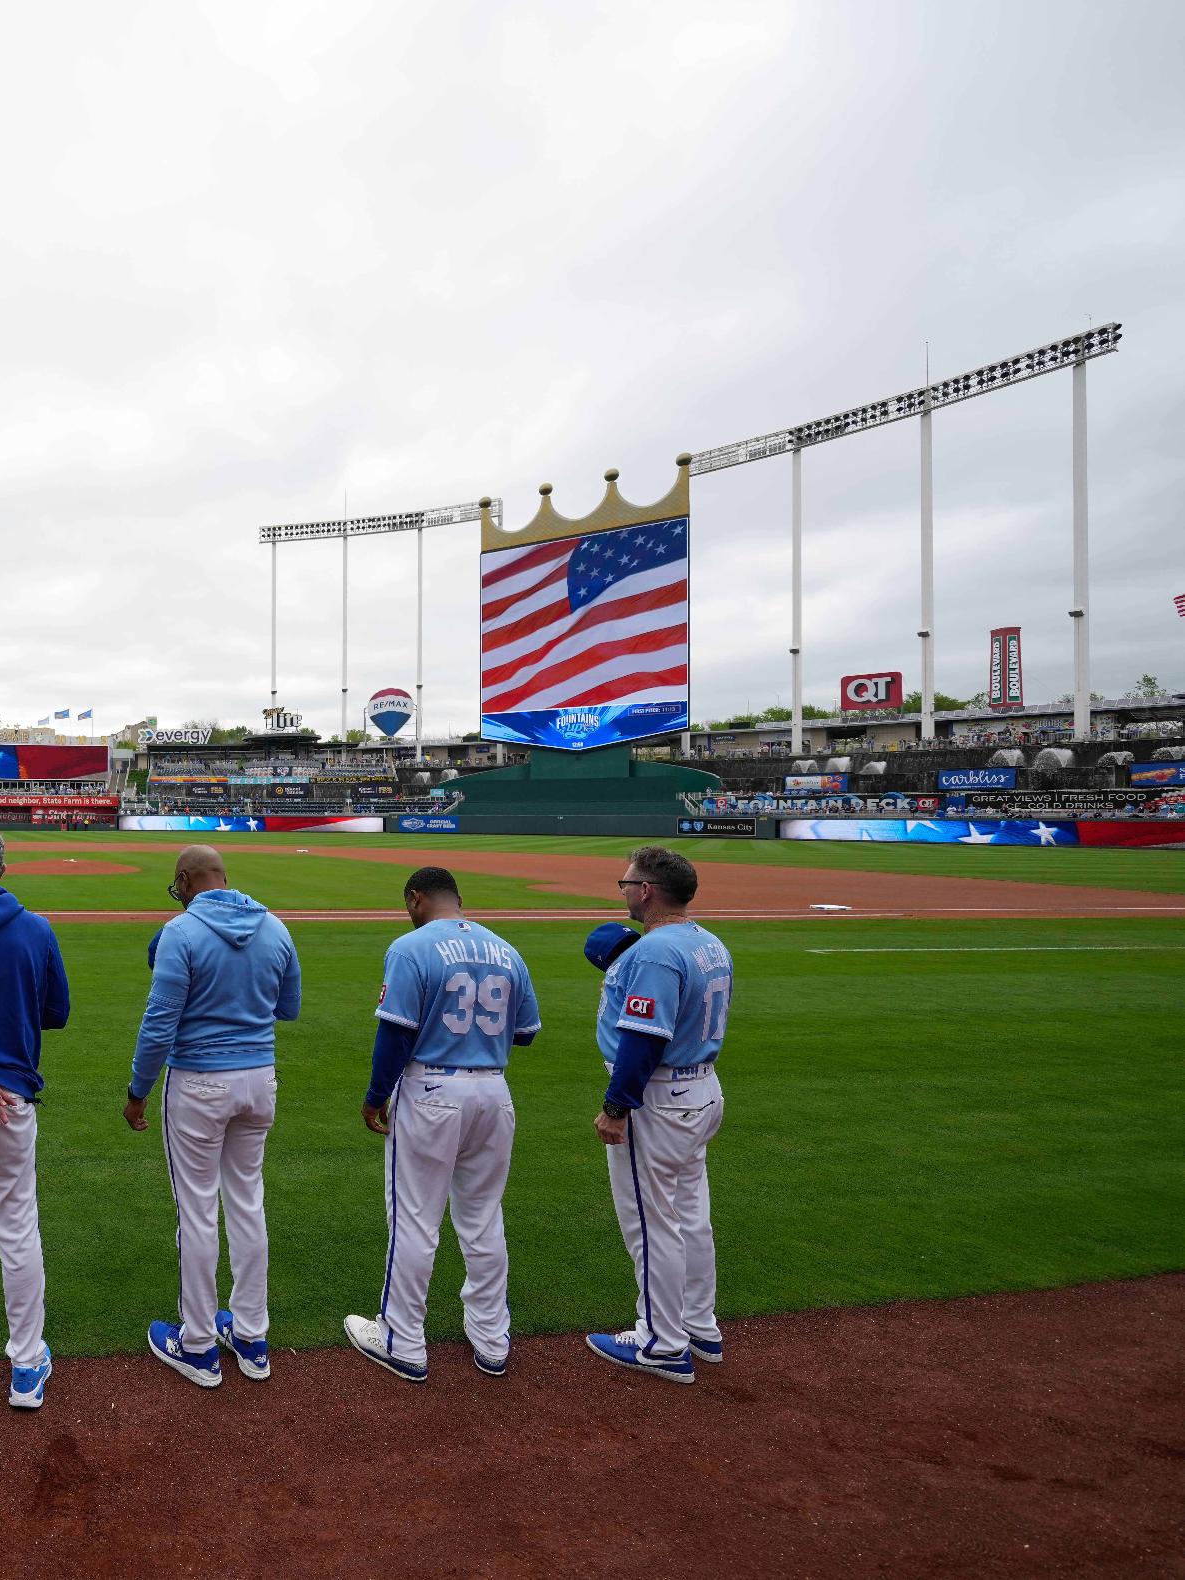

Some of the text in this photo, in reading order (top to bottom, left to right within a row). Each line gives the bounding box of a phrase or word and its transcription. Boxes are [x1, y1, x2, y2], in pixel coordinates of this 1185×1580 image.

[991, 641, 1001, 698] BOULEVARD
[1008, 640, 1020, 697] BOULEVARD
[846, 677, 895, 703] QT
[373, 700, 408, 711] RE/MAX
[266, 712, 302, 731] Lite
[556, 713, 599, 730] FOUNTAINS
[156, 729, 211, 744] evergy
[942, 770, 1010, 786] carbliss
[8, 796, 41, 805] neighbor,
[42, 796, 62, 804] State
[63, 797, 82, 805] Farm
[91, 797, 113, 805] there.
[849, 798, 912, 811] DECK
[918, 799, 935, 808] QT
[1108, 793, 1147, 801] FOOD
[737, 823, 753, 831] City
[435, 939, 512, 970] HOLLINS
[442, 972, 512, 1036] 39
[629, 998, 650, 1014] QT
[701, 975, 731, 1043] 17
